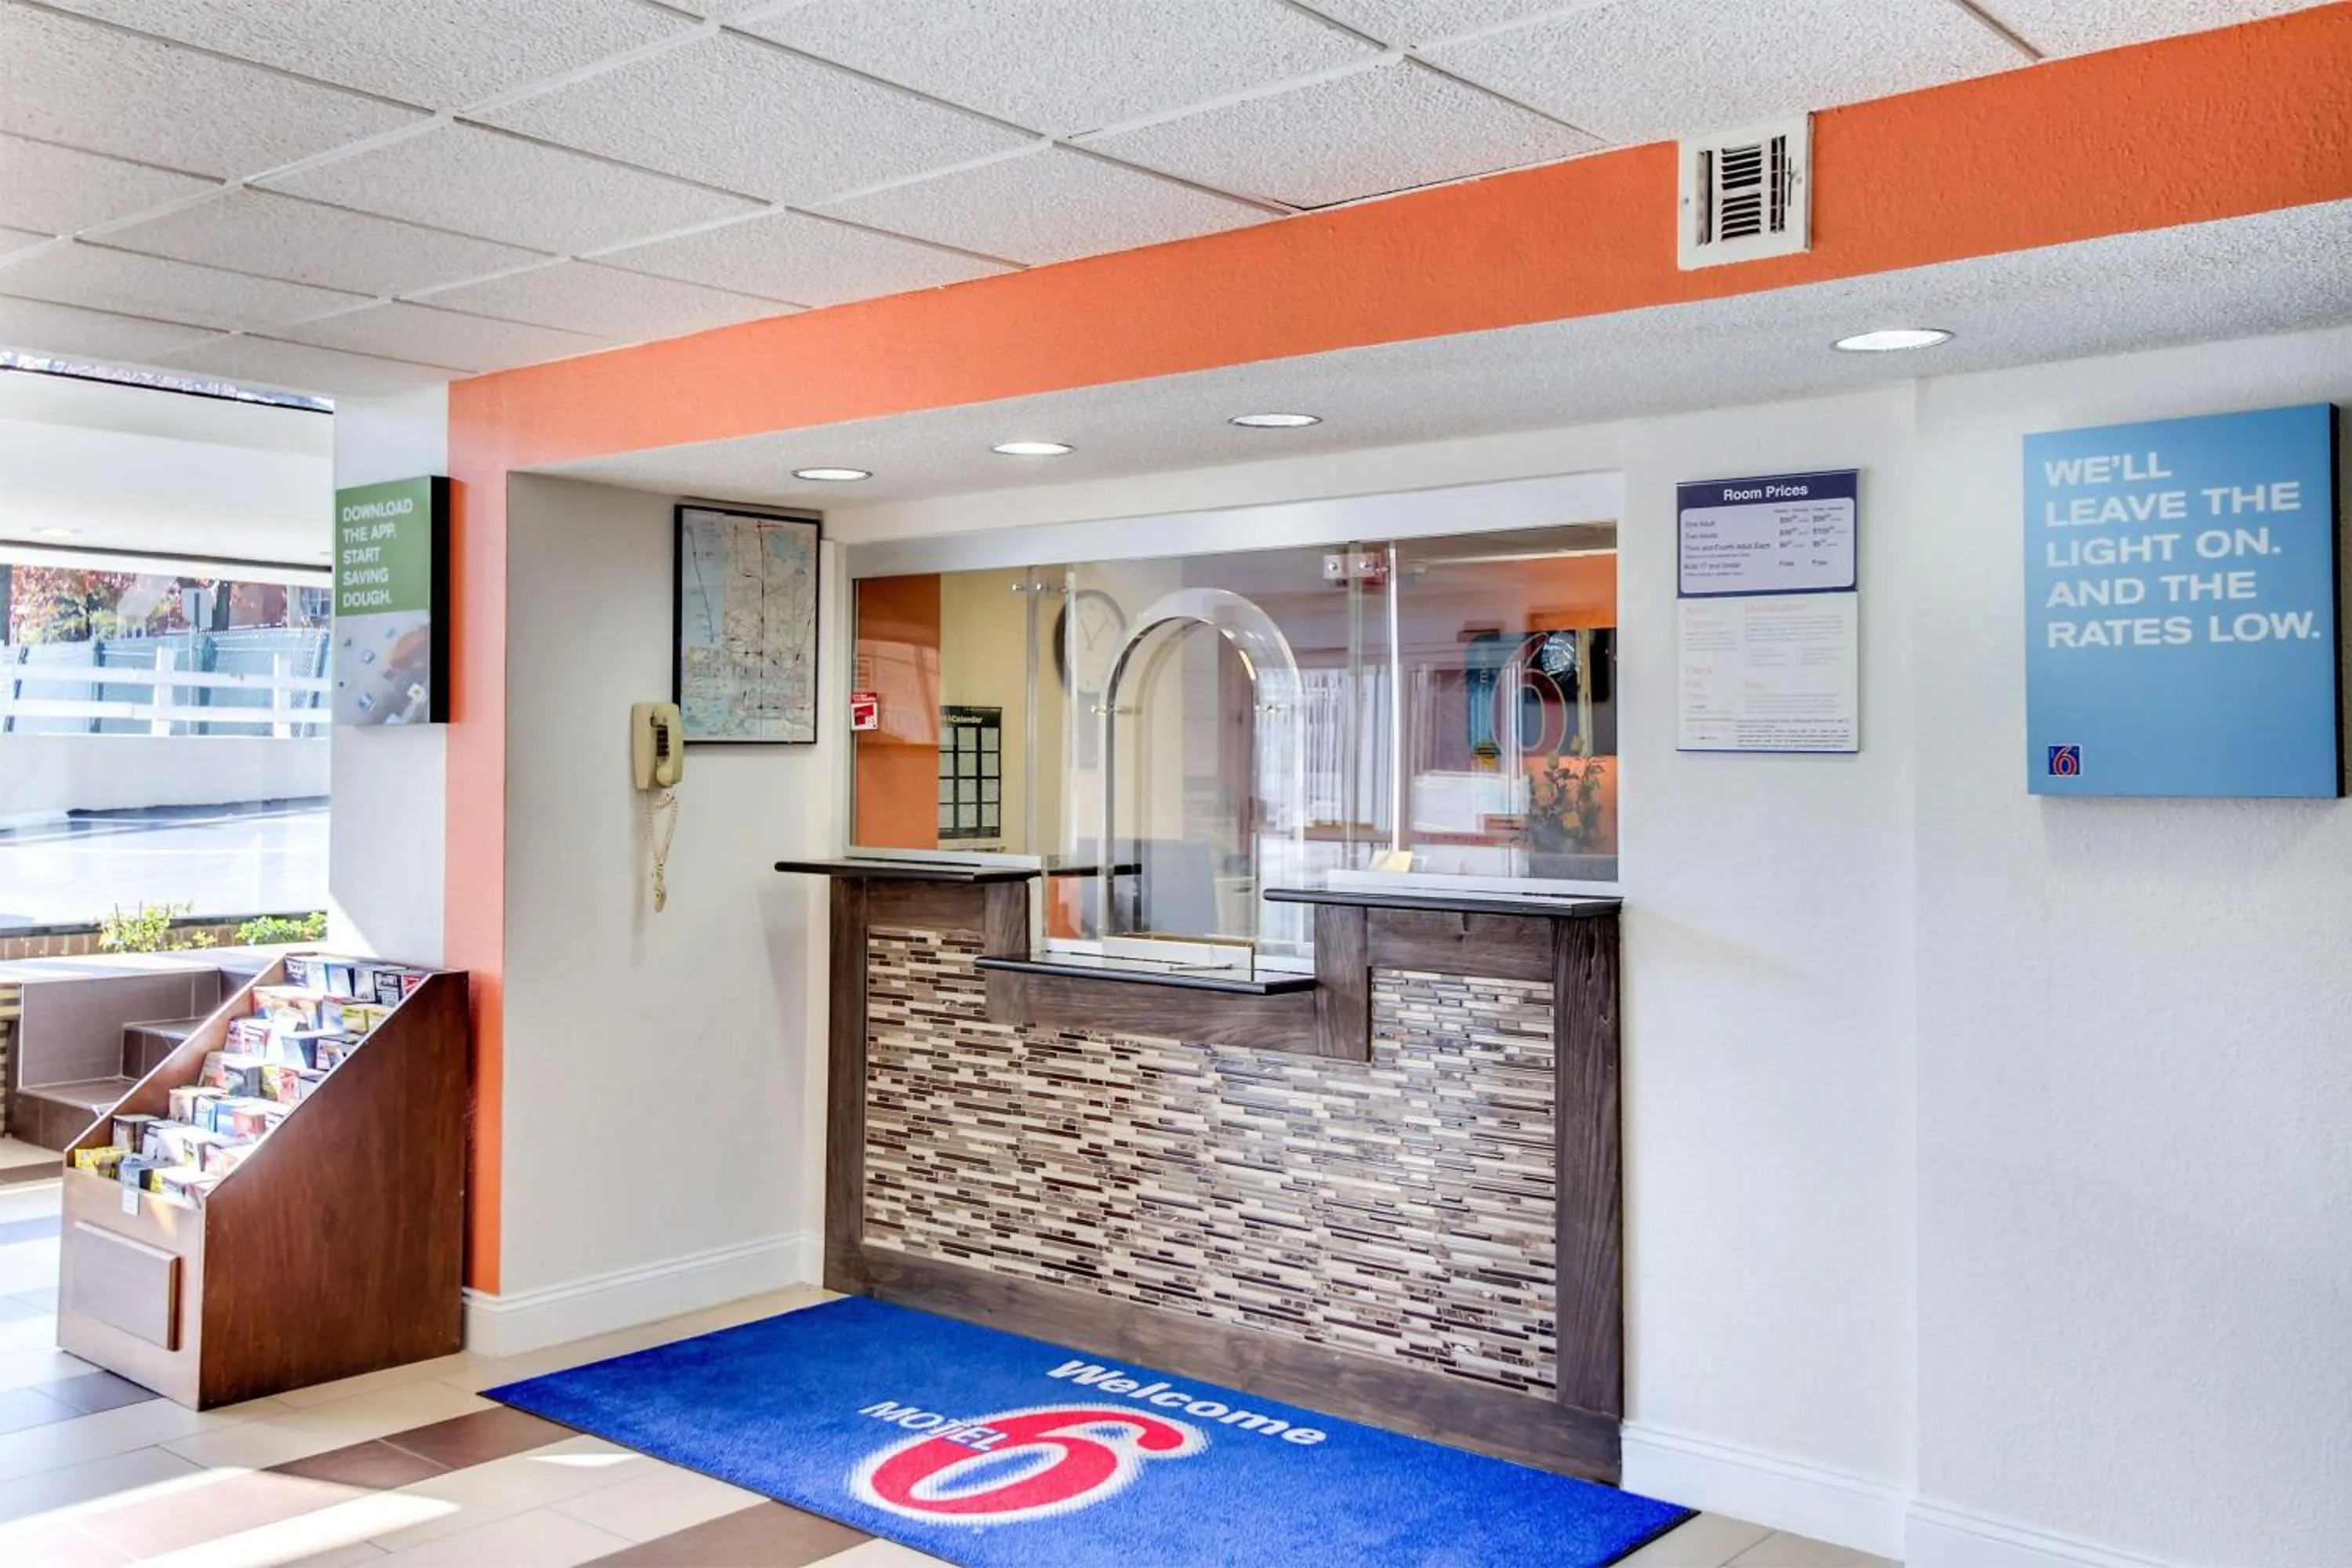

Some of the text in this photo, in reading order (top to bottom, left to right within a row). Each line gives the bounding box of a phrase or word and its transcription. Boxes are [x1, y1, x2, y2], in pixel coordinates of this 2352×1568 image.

[2045, 452, 2172, 487] WE'LL
[343, 498, 413, 522] DOWNLOAD
[1724, 485, 1809, 501] Room Prices
[2045, 481, 2301, 528] LEAVE THE
[343, 523, 397, 543] THE APP.
[2046, 527, 2282, 568] LIGHT ON.
[343, 547, 381, 564] START
[343, 568, 389, 586] SAVING
[2045, 571, 2256, 608] AND THE
[343, 590, 393, 608] DOUGH.
[2047, 611, 2321, 648] RATES LOW.
[2053, 743, 2078, 777] 6
[1046, 1360, 1327, 1445] Welcome
[858, 1401, 1012, 1453] MOTEL
[858, 1406, 1200, 1519] 6
